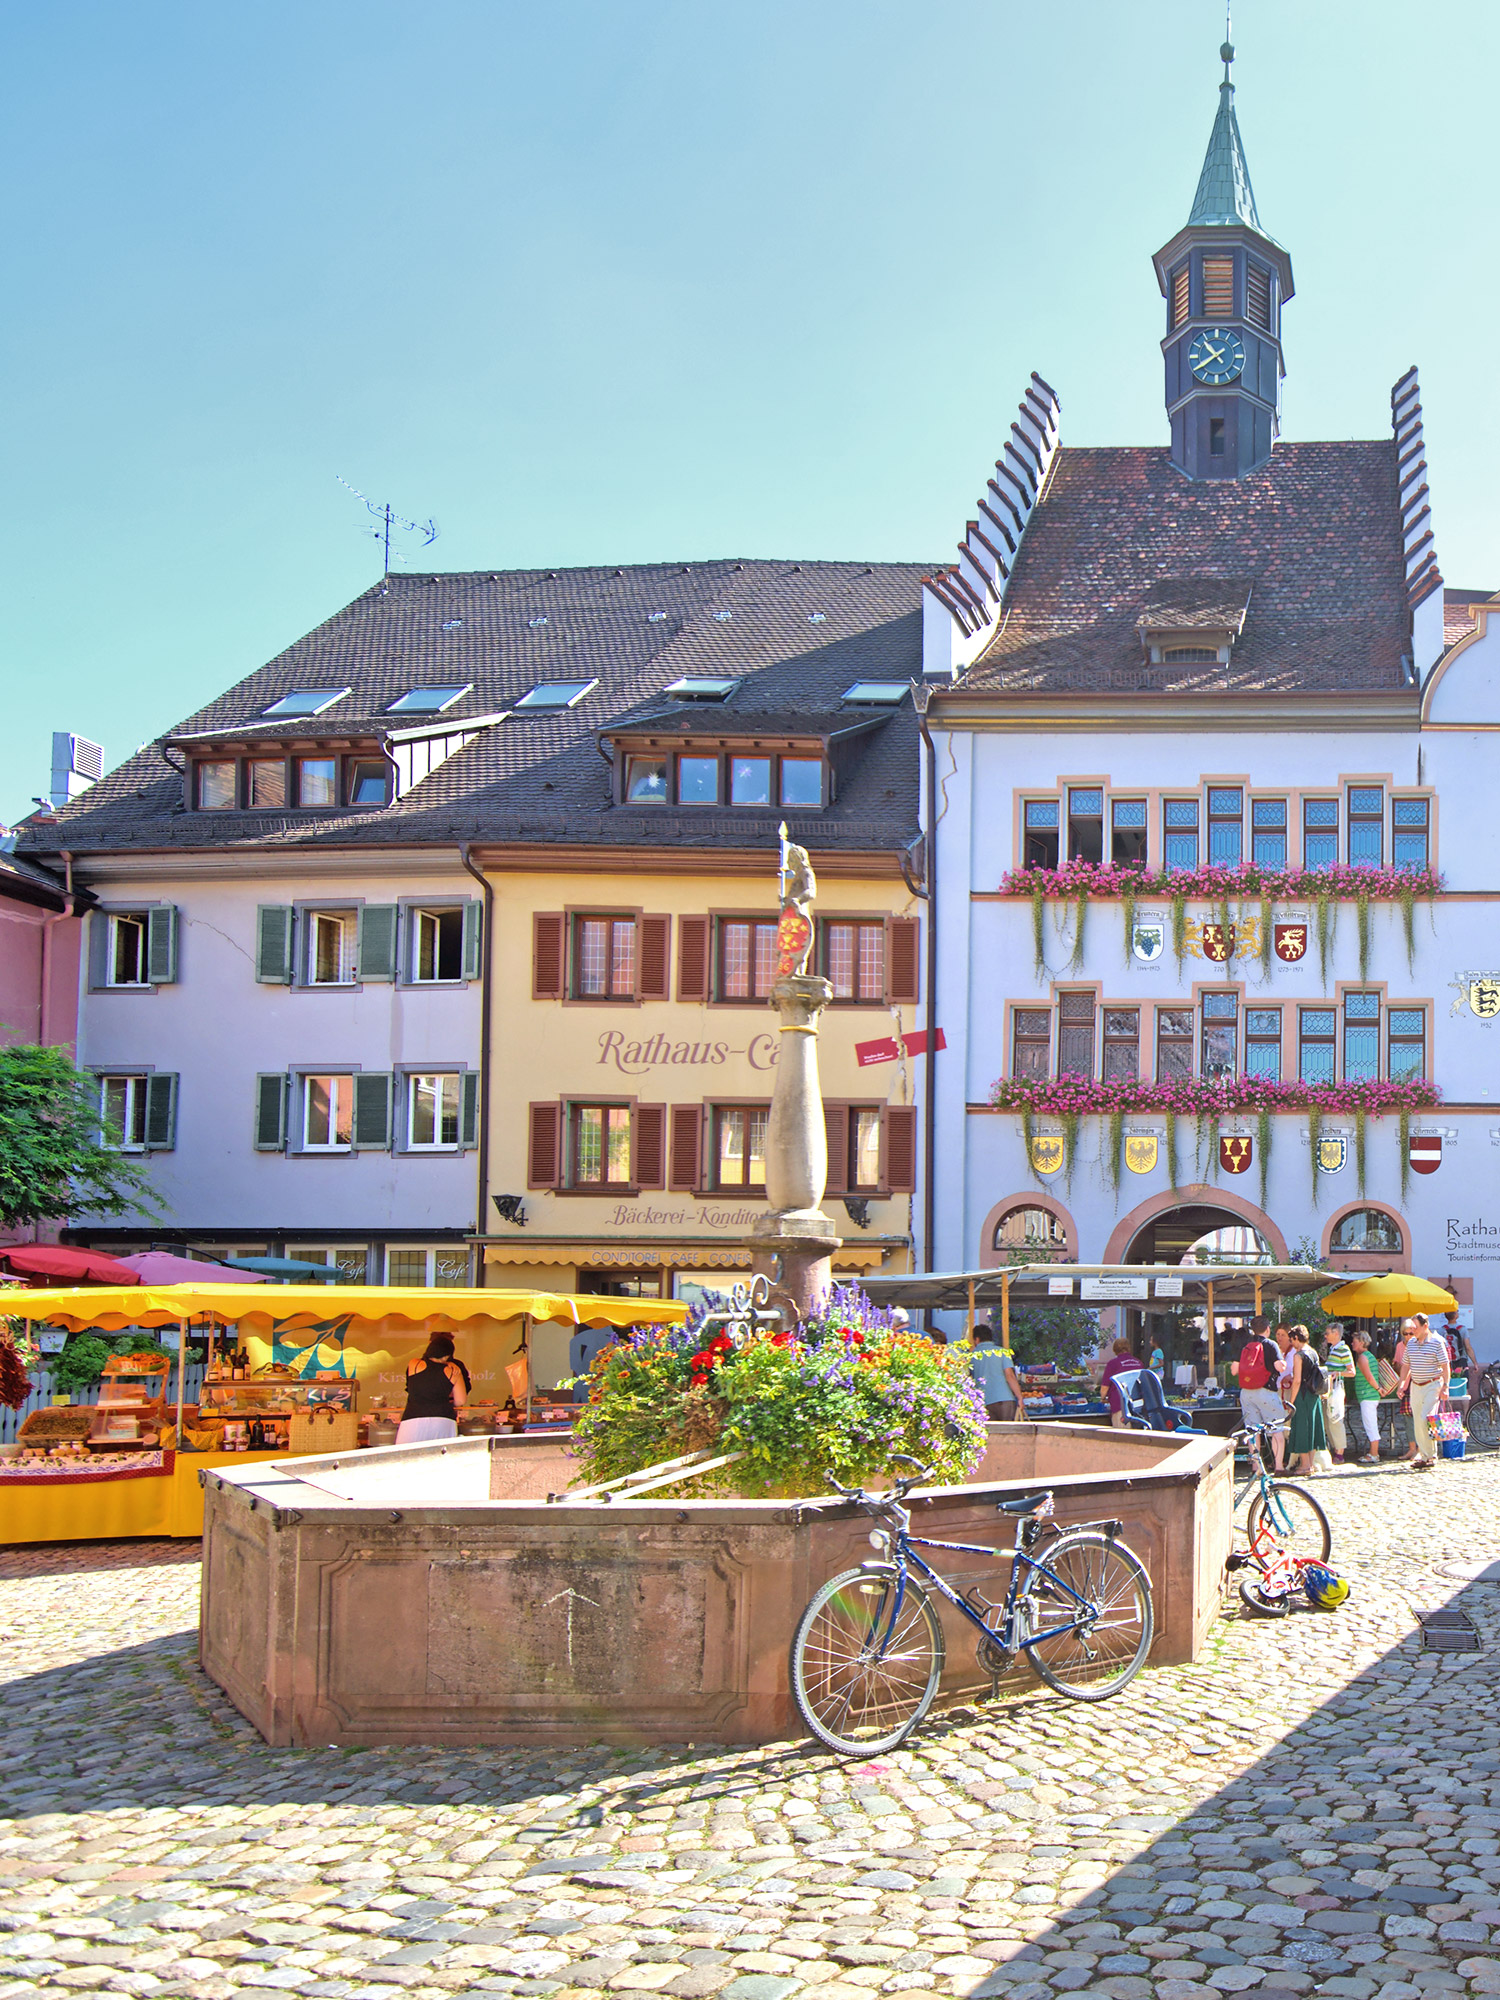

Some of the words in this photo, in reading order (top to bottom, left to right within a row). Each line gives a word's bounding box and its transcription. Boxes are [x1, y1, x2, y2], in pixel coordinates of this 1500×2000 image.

[596, 1030, 781, 1075] Rathaus-Ca
[1446, 1218, 1500, 1237] Ratha
[591, 1251, 661, 1262] CONDITOREI
[1447, 1253, 1500, 1262] Touristinforma
[437, 1259, 469, 1280] Café
